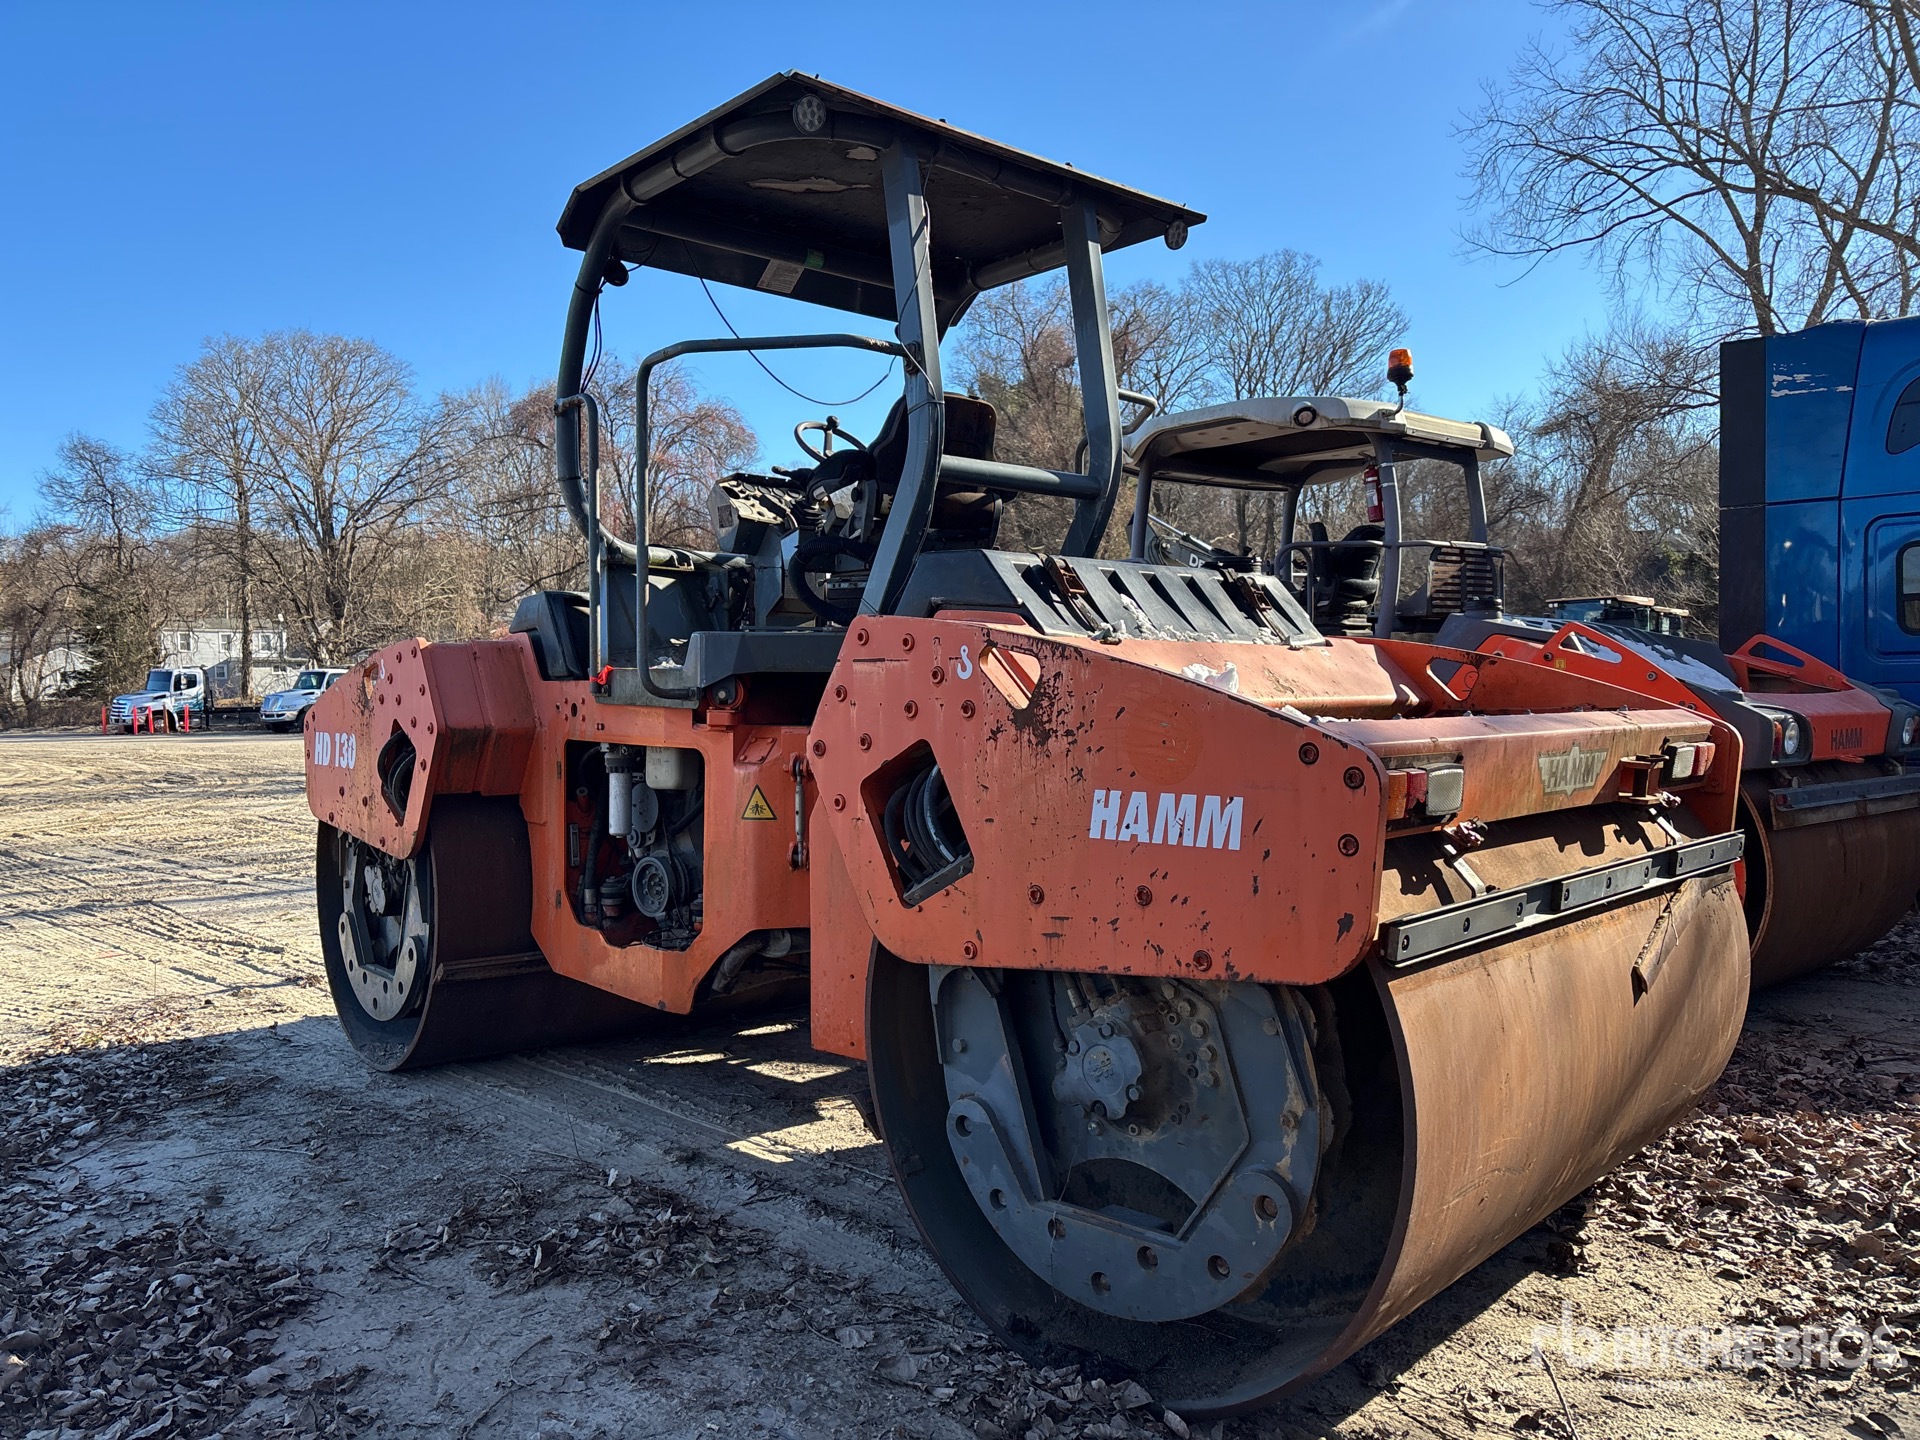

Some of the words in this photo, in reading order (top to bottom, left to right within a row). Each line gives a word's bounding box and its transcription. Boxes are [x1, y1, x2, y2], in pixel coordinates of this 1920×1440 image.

[314, 731, 331, 766] HD
[335, 732, 357, 769] 130
[1830, 727, 1863, 751] HAMM
[1546, 753, 1597, 789] HAMM
[1089, 789, 1244, 851] HAMM
